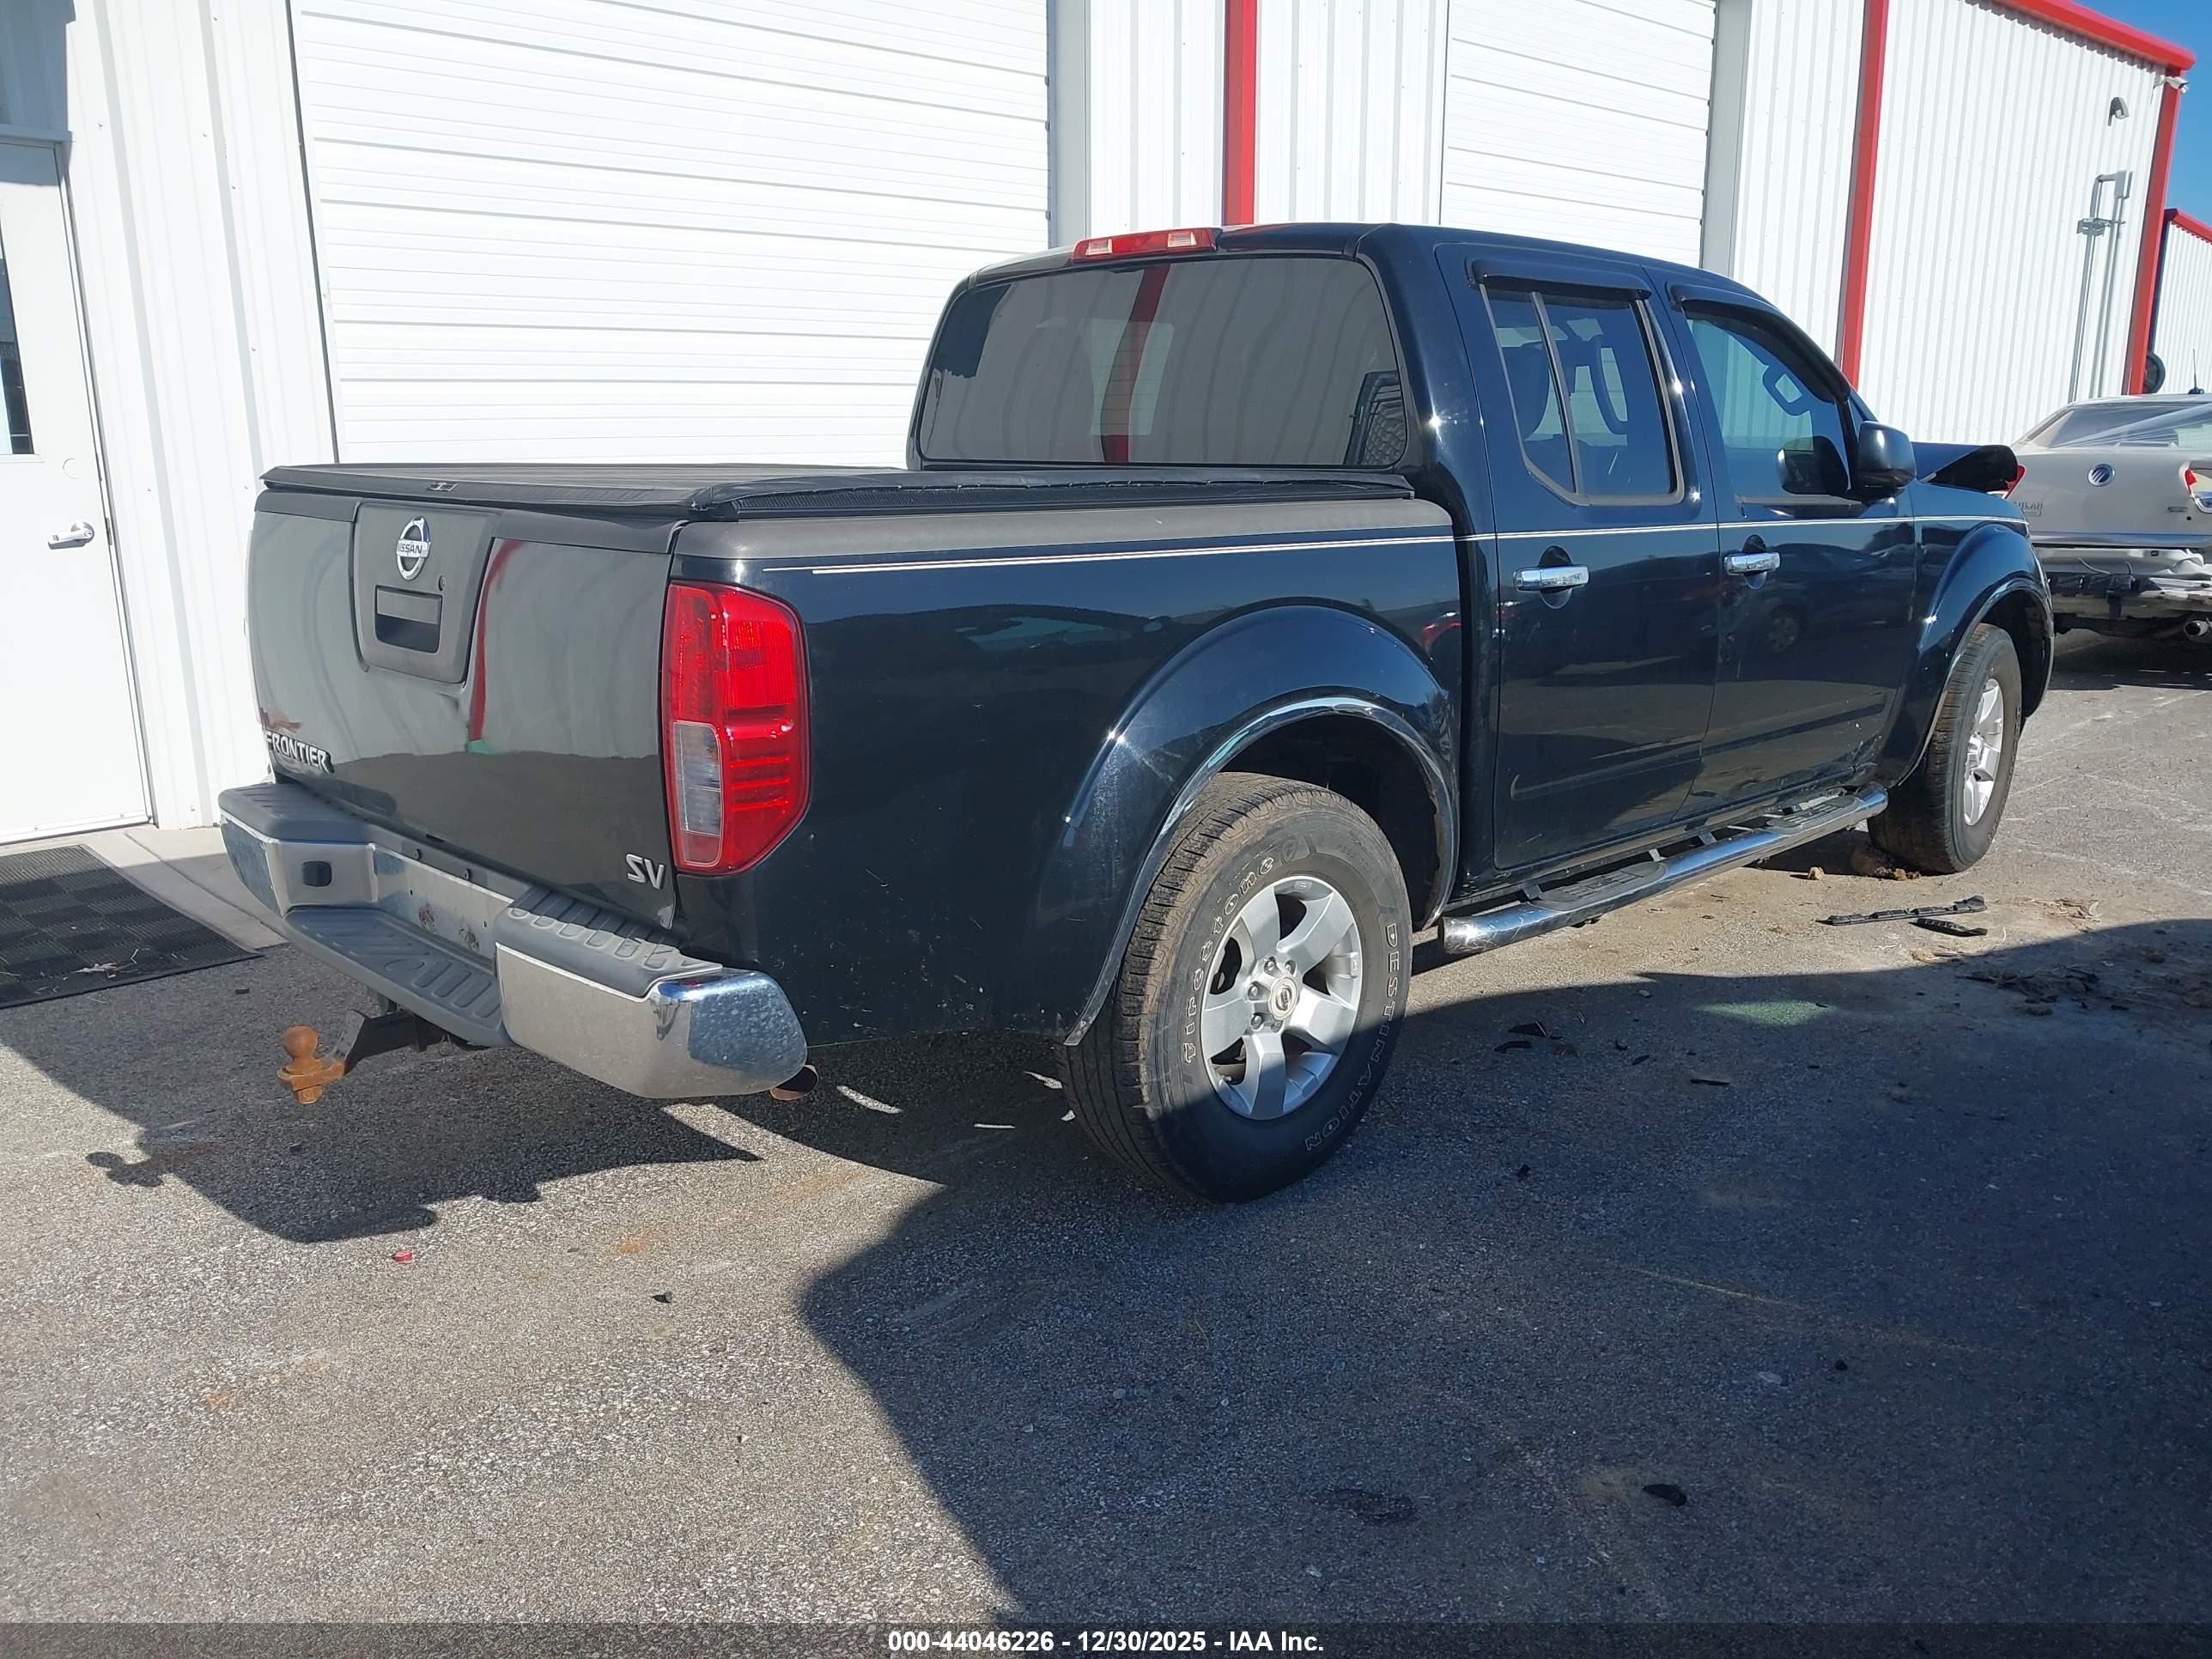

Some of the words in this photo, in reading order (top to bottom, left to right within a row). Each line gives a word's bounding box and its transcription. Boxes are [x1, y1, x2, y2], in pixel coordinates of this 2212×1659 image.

[266, 730, 331, 774] FRONTIER
[625, 854, 665, 890] SV
[1304, 921, 1401, 1152] DESTINATION
